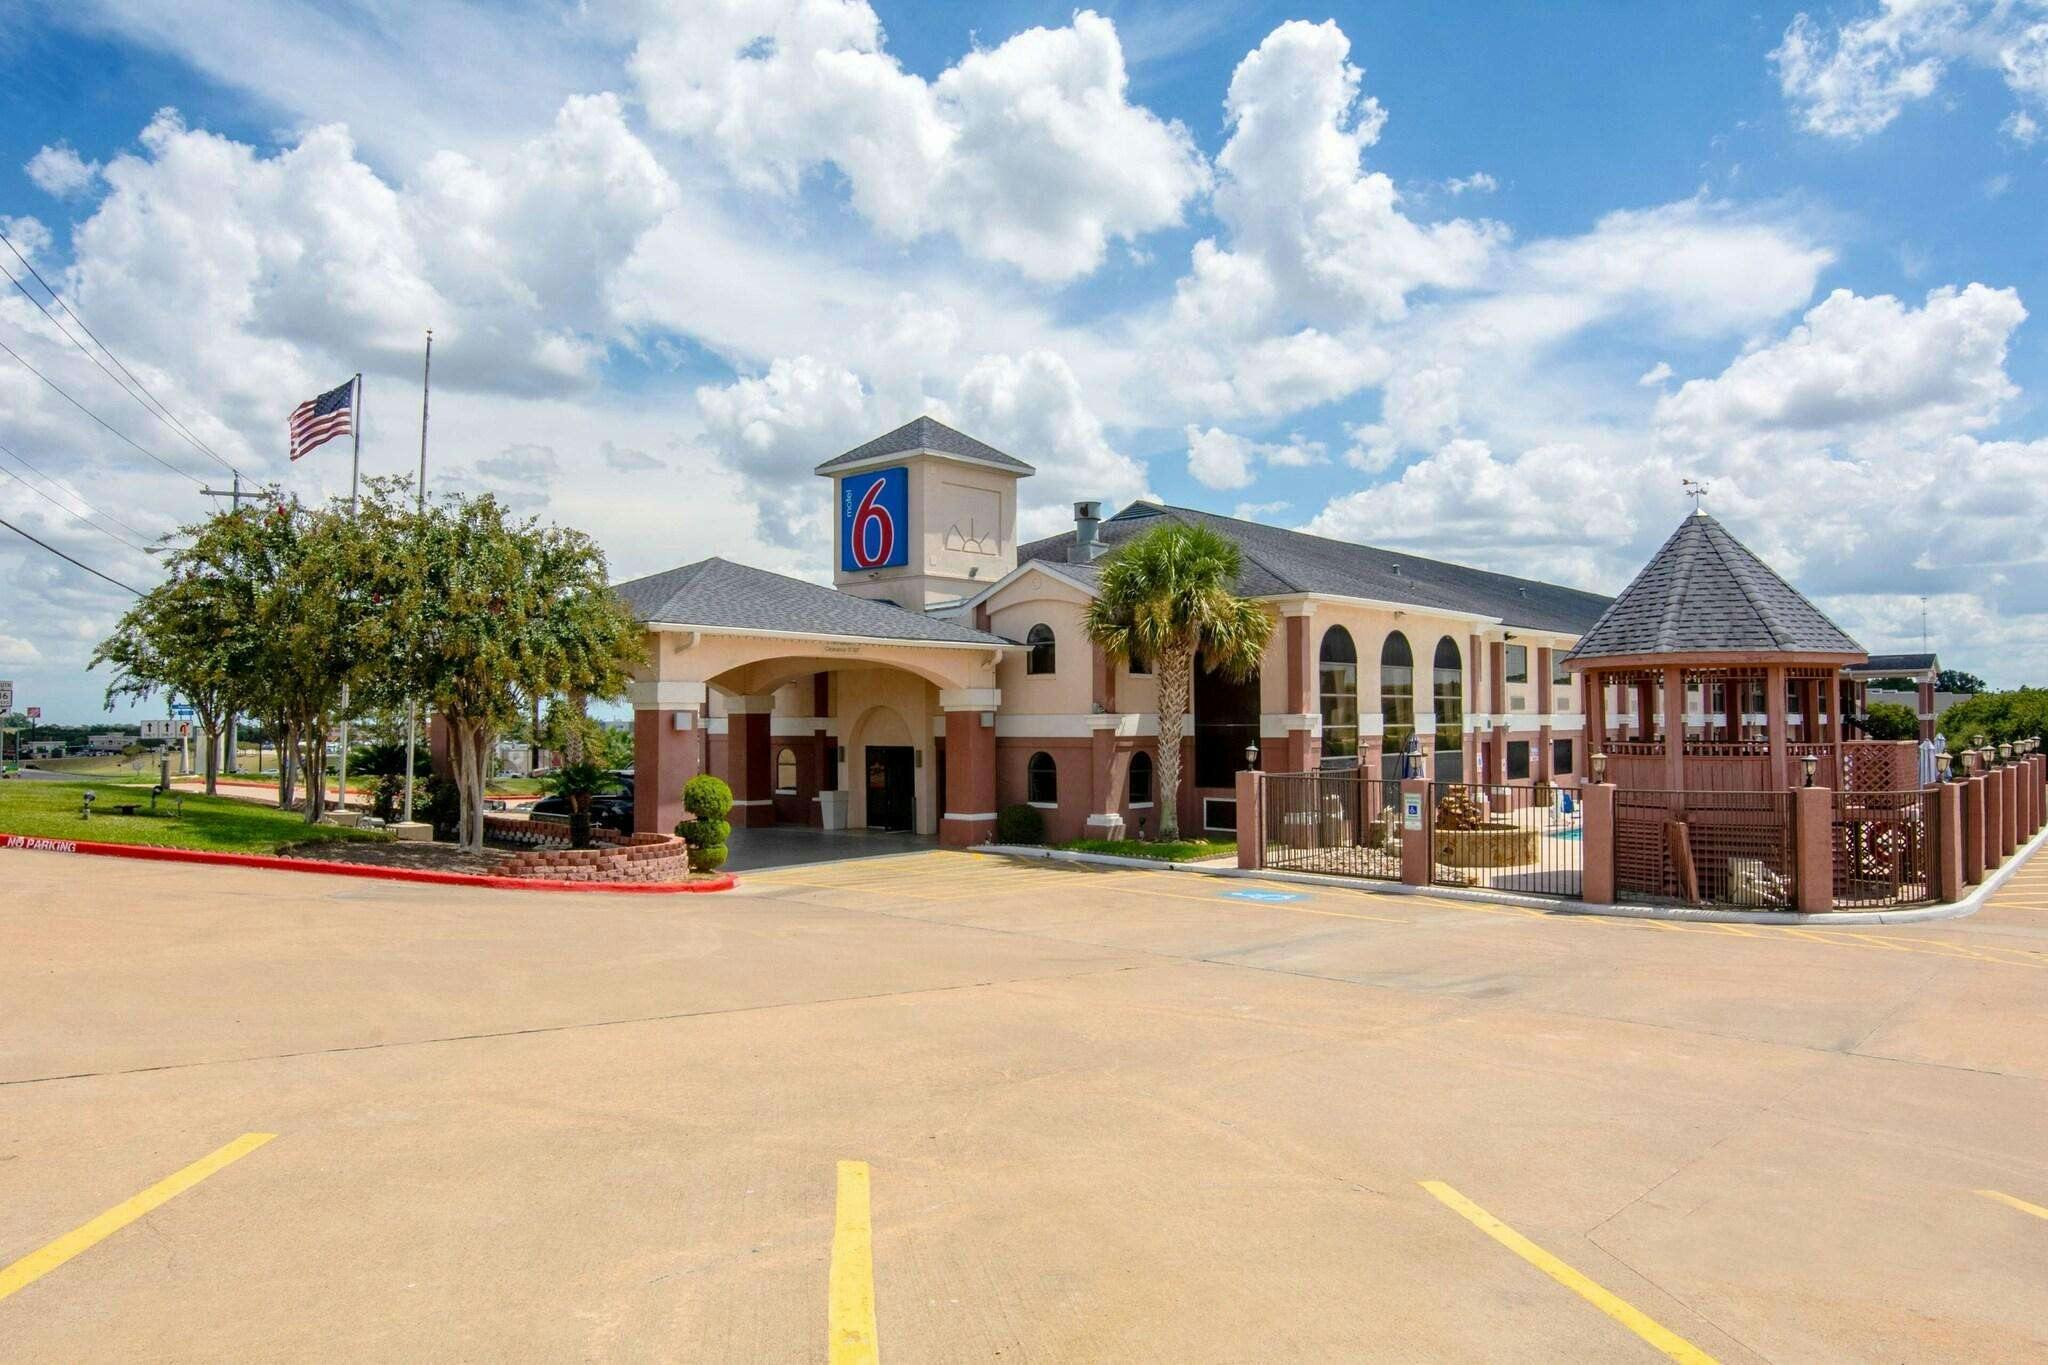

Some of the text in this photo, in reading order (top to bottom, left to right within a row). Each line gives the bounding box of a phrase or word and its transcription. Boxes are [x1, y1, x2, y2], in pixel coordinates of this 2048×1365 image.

[851, 477, 894, 568] 6
[7, 837, 77, 852] NO PARKING
